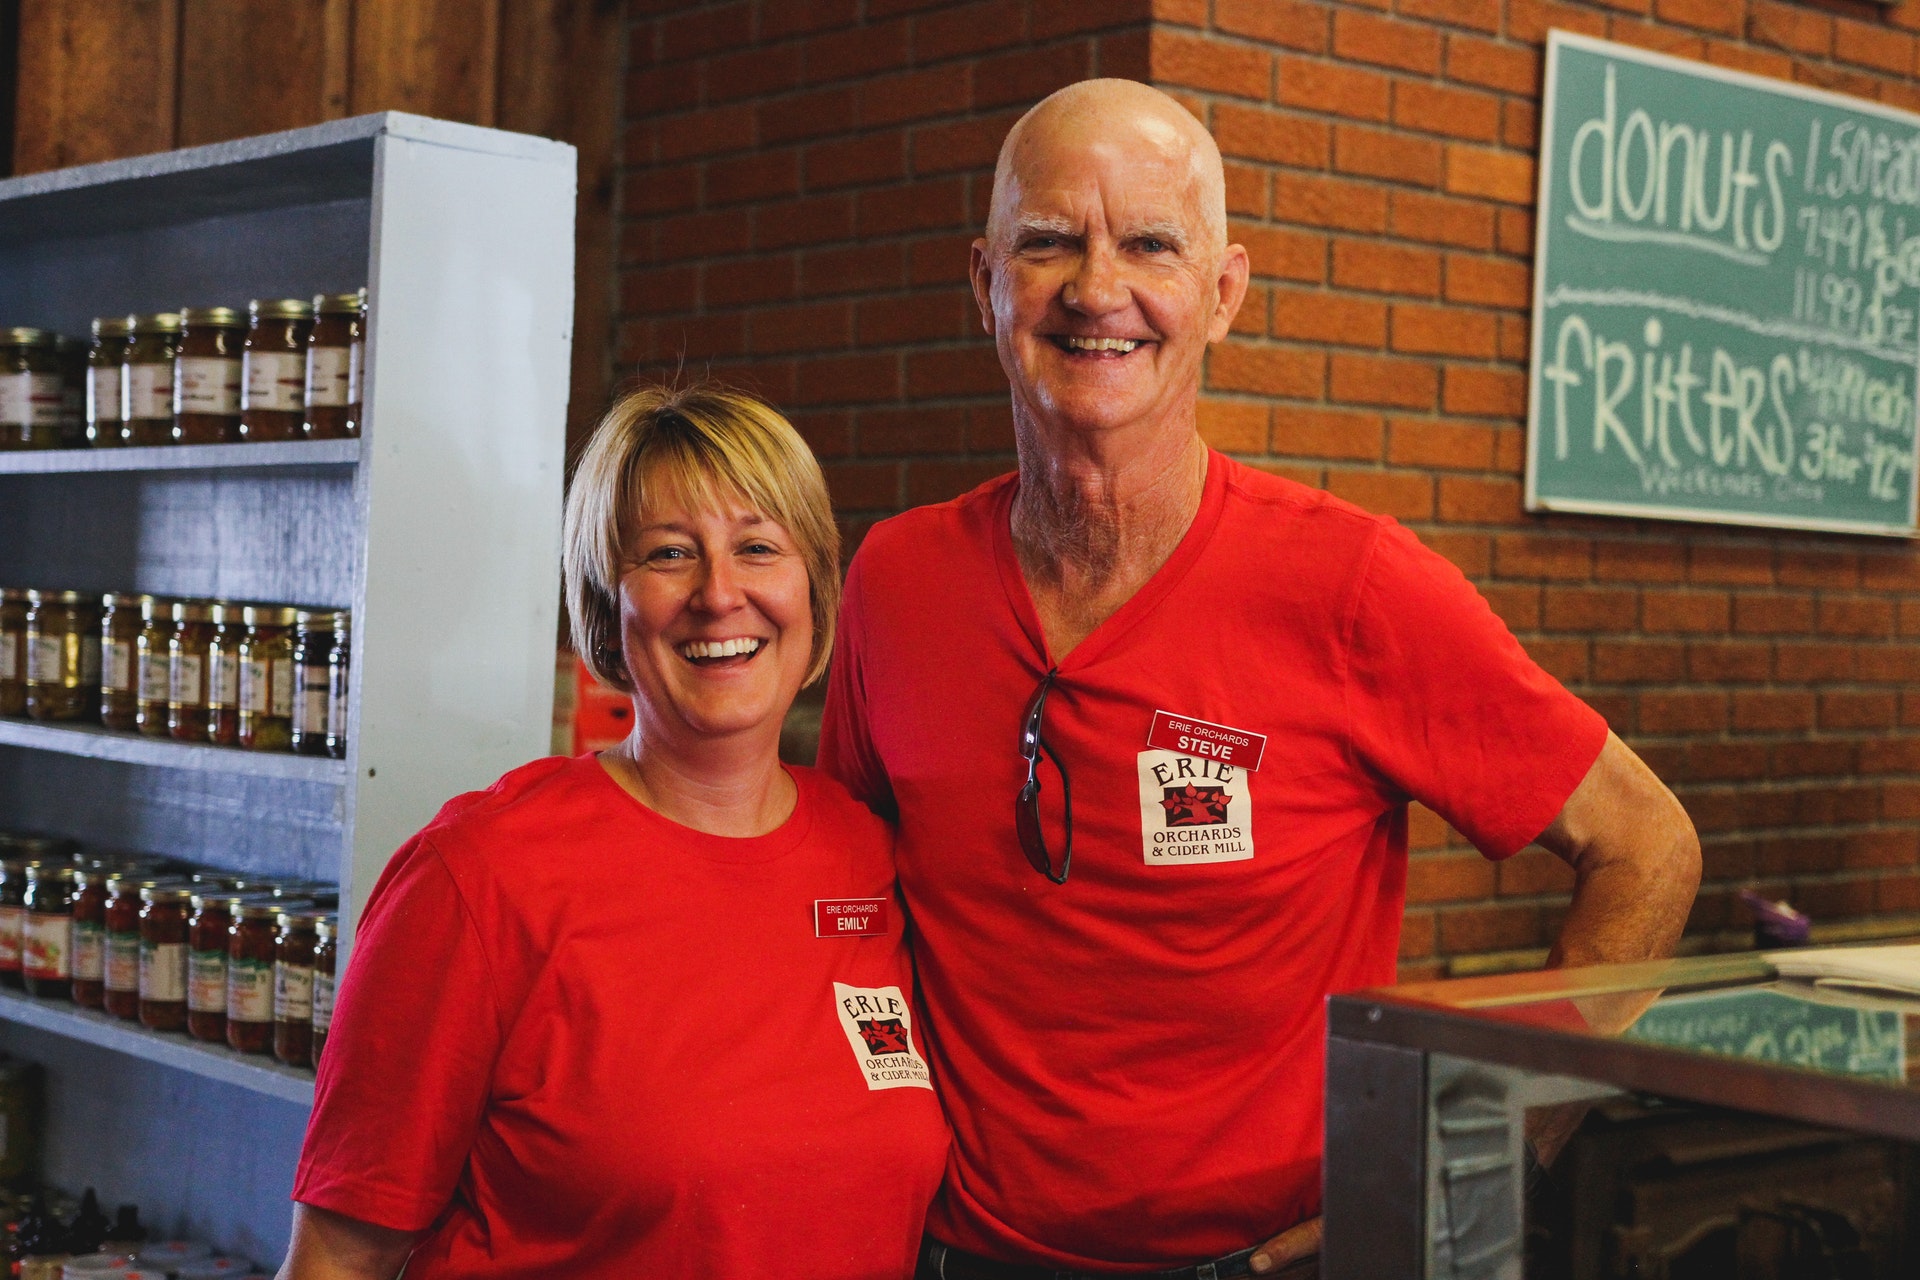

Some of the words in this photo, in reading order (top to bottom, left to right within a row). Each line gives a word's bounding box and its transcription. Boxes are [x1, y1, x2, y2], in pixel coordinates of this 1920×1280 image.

[1568, 62, 1794, 252] donuts
[1168, 720, 1193, 733] ERIE
[1193, 726, 1250, 747] ORCHARDS
[1177, 735, 1234, 760] STEVE
[1151, 757, 1235, 787] ERIE
[1153, 827, 1242, 844] ORCHARDS
[1152, 846, 1164, 857] &
[1167, 844, 1210, 857] CIDER
[1214, 841, 1246, 854] MILL
[826, 905, 842, 914] ERIE
[842, 904, 879, 914] ORCHARDS
[837, 916, 869, 931] EMILY
[843, 995, 903, 1019] ERIE
[866, 1056, 923, 1070] ORCHARDS
[870, 1071, 881, 1082] &
[881, 1069, 911, 1082] CIDER
